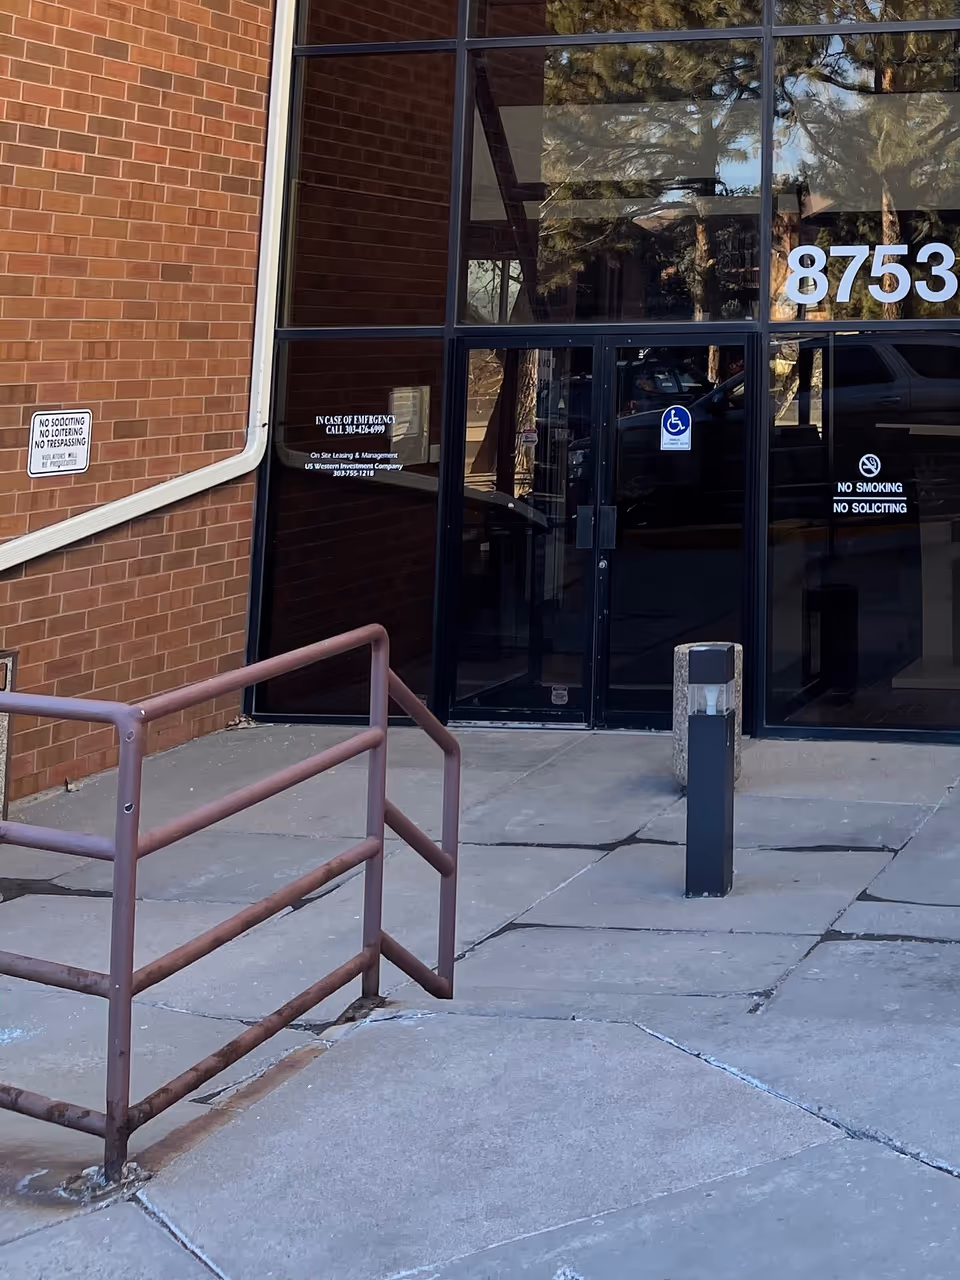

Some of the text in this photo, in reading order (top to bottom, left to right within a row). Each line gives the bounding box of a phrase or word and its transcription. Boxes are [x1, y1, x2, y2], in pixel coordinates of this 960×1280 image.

[785, 242, 958, 304] 8753
[39, 417, 85, 428] NO SOLICITING
[315, 415, 324, 425] IN
[324, 415, 342, 425] CASE
[343, 415, 353, 425] OF
[40, 427, 84, 438] NO LOITERING
[326, 425, 344, 434] CALL
[35, 437, 86, 449] NO TRESPASSING
[332, 452, 353, 460] Leasing
[361, 452, 398, 460] Management
[374, 462, 403, 470] Company
[837, 482, 903, 493] NO SMOKING
[833, 502, 907, 513] NO SOLICITING
